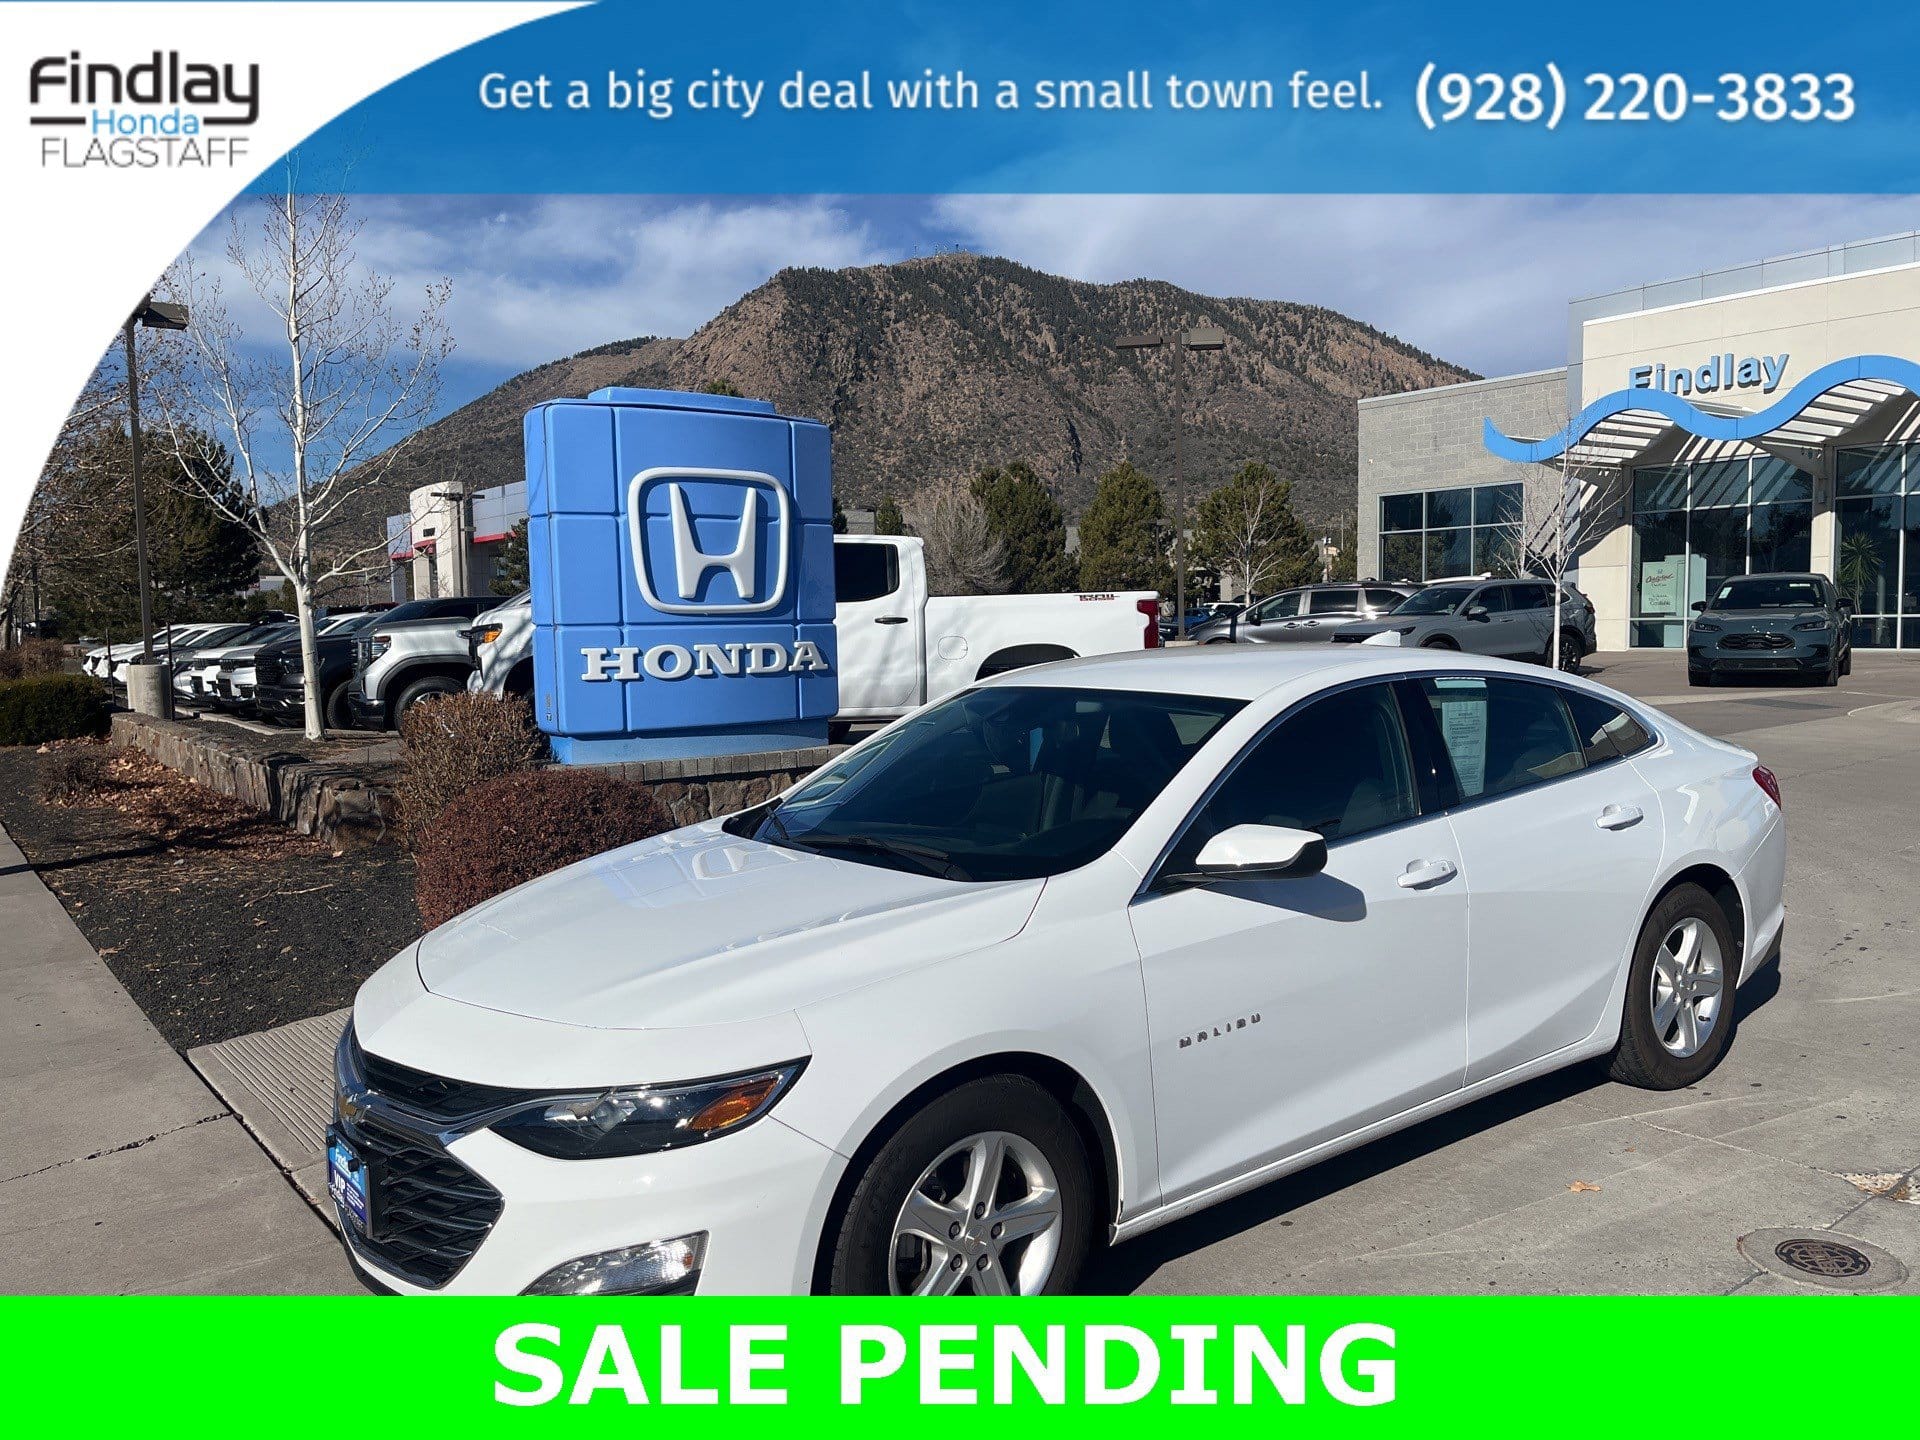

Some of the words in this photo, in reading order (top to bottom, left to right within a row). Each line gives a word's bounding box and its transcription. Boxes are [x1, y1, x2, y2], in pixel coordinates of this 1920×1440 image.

[1628, 353, 1790, 396] Findlay
[580, 641, 829, 681] HONDA
[1179, 1012, 1261, 1049] MALIBU
